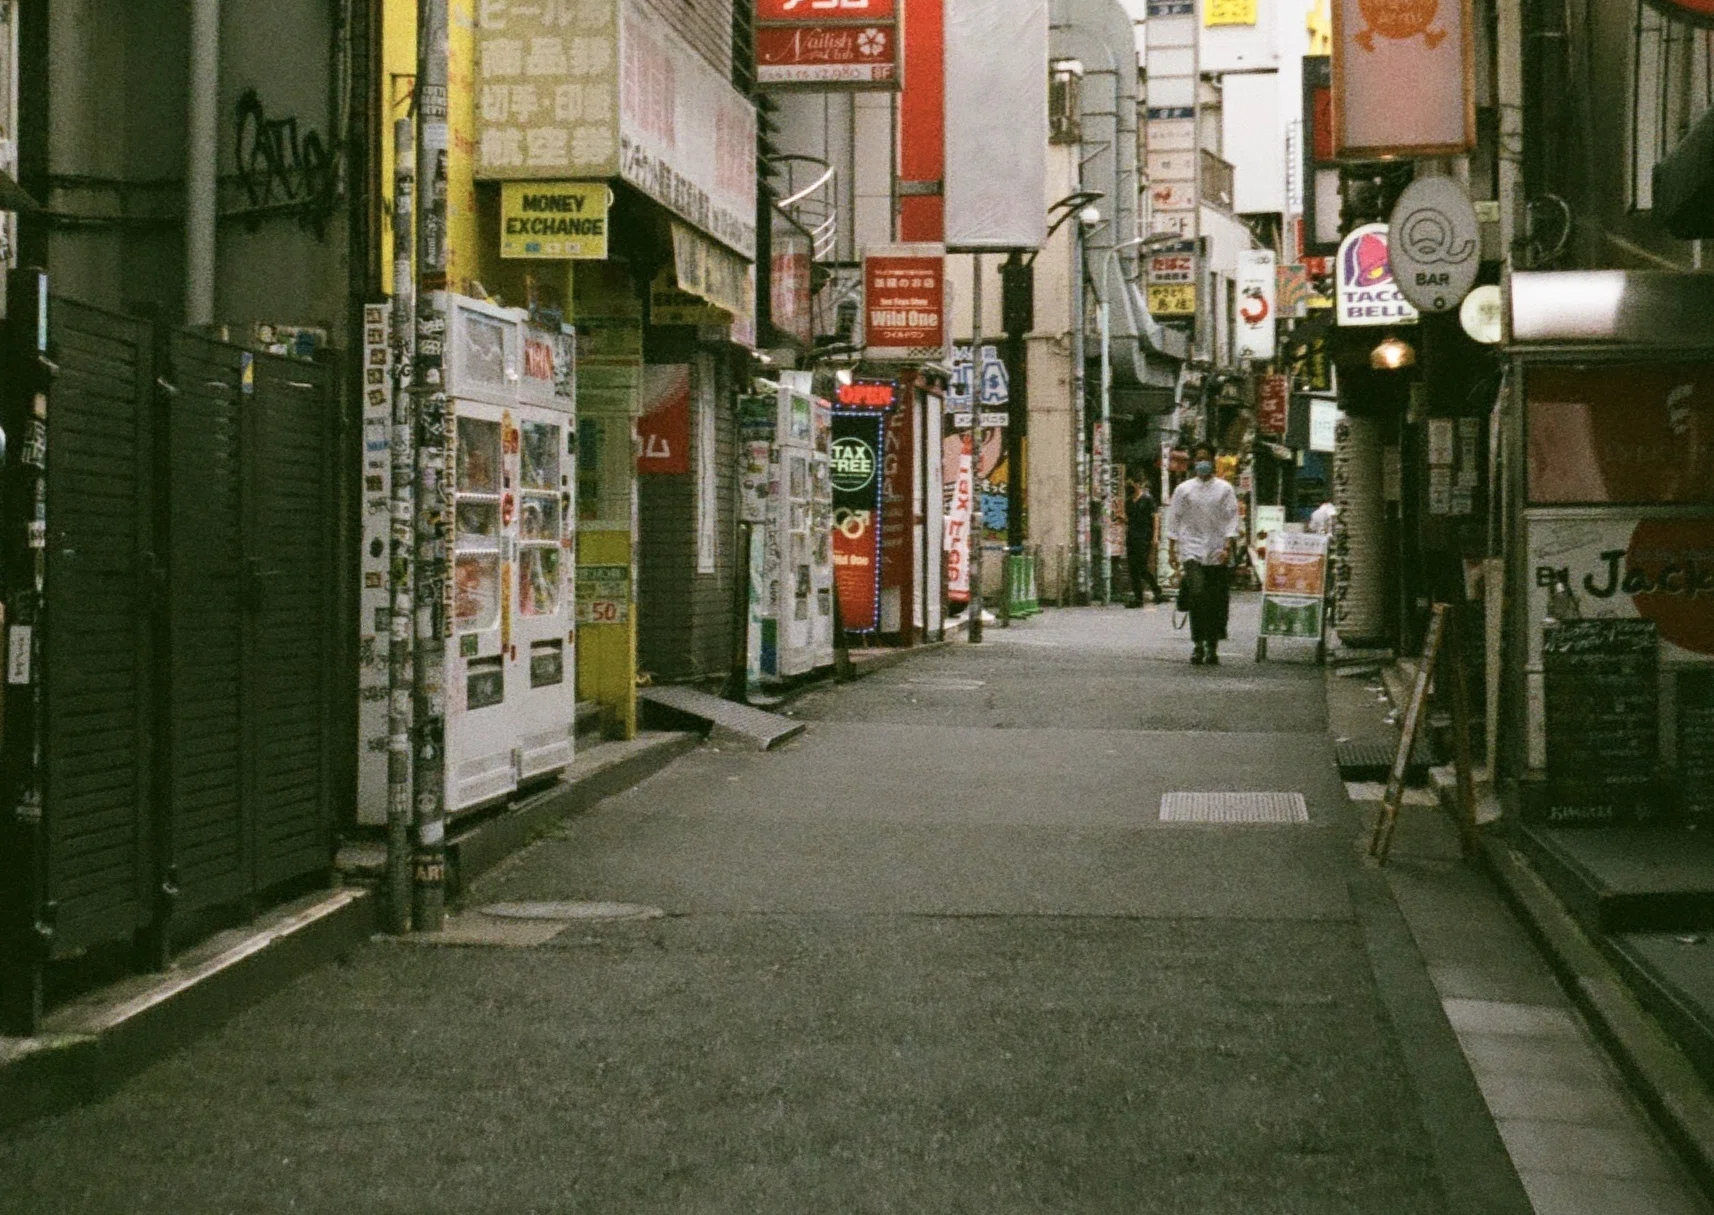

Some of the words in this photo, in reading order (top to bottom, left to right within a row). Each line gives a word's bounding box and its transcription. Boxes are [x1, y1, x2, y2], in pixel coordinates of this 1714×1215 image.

[522, 194, 585, 213] MONEY
[506, 217, 604, 235] EXCHANGE
[1416, 273, 1450, 286] BAR
[871, 311, 906, 326] Wild
[908, 311, 938, 326] One
[1347, 306, 1412, 319] BELL
[840, 386, 892, 404] OPEN
[834, 446, 866, 459] TAX
[830, 459, 871, 473] FREE
